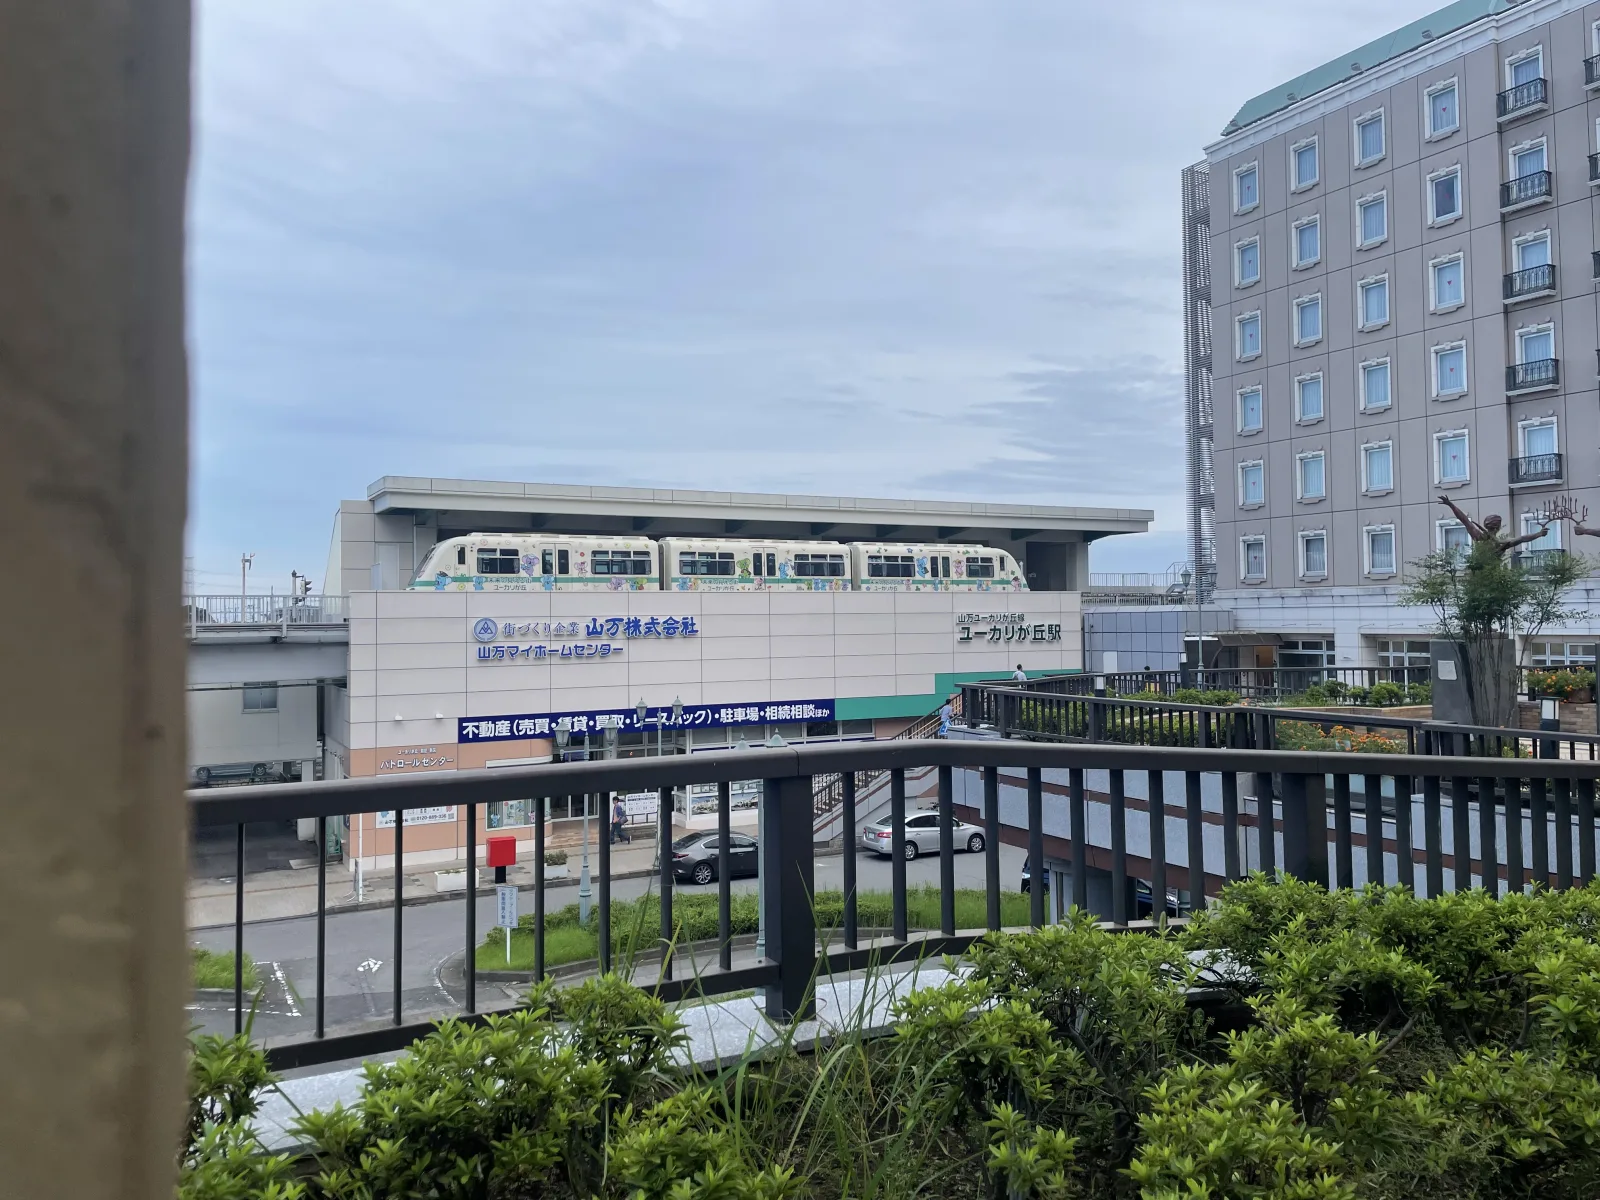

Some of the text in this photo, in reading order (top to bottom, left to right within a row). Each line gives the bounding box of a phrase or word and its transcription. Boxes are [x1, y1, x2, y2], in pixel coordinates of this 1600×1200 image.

[503, 616, 699, 637] 街づくり企業 山万株式会社
[959, 623, 1062, 641] ユーカリが丘駅
[477, 643, 624, 660] 山万マイホームセンター
